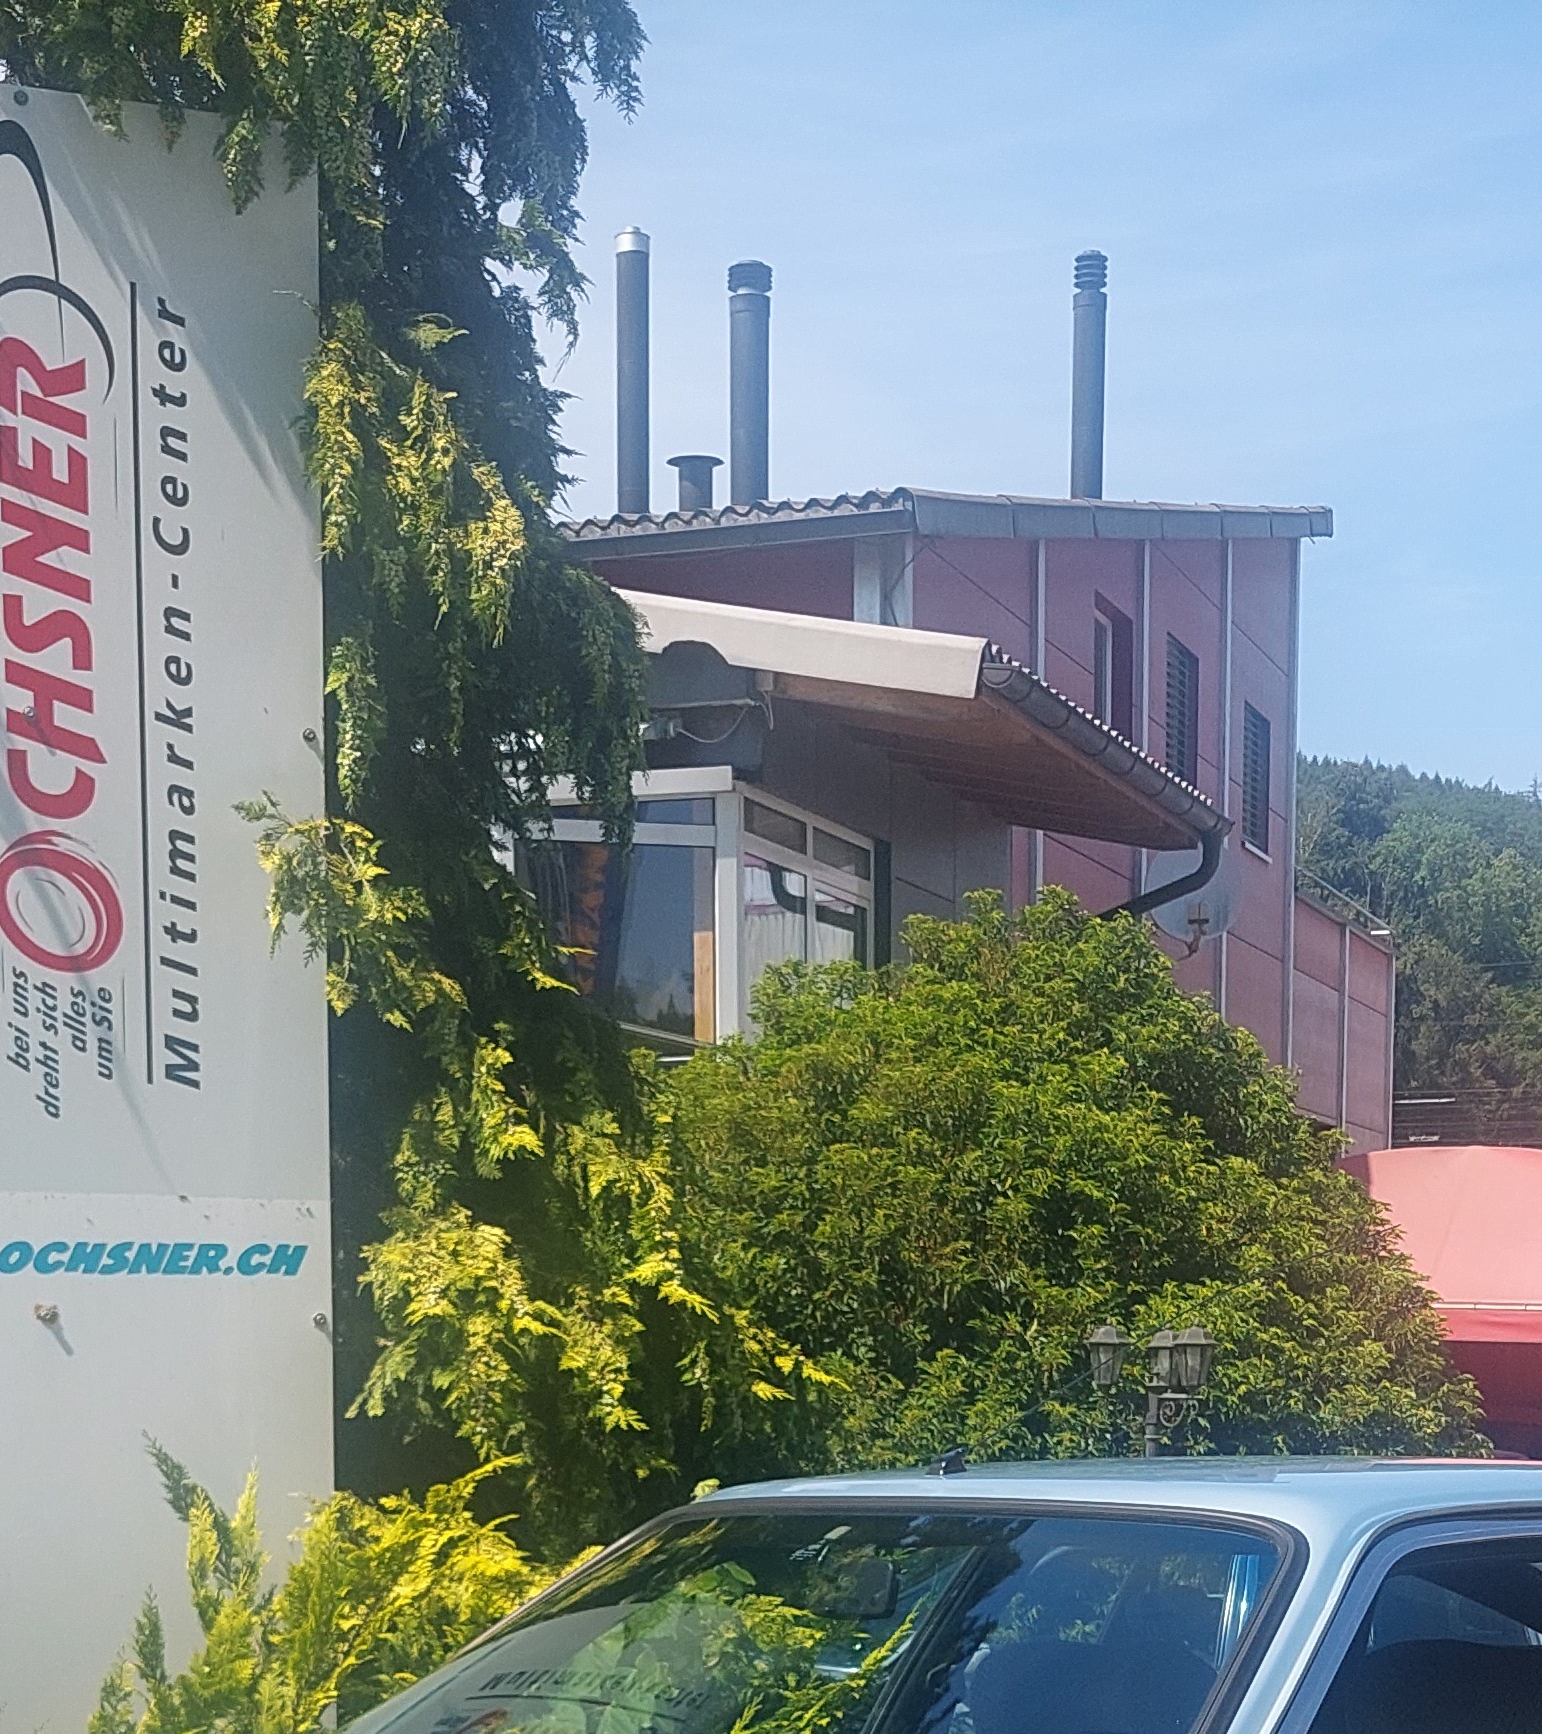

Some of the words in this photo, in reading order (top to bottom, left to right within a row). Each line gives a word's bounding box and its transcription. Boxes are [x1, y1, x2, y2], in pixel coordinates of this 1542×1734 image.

[151, 296, 202, 1091] Multimarken-Center
[12, 966, 30, 1018] uns
[33, 981, 58, 1036] sich
[90, 987, 114, 1031] Sie
[63, 986, 88, 1053] alles
[7, 1022, 31, 1073] bei
[97, 1036, 114, 1080] um
[35, 1041, 60, 1119] dreht
